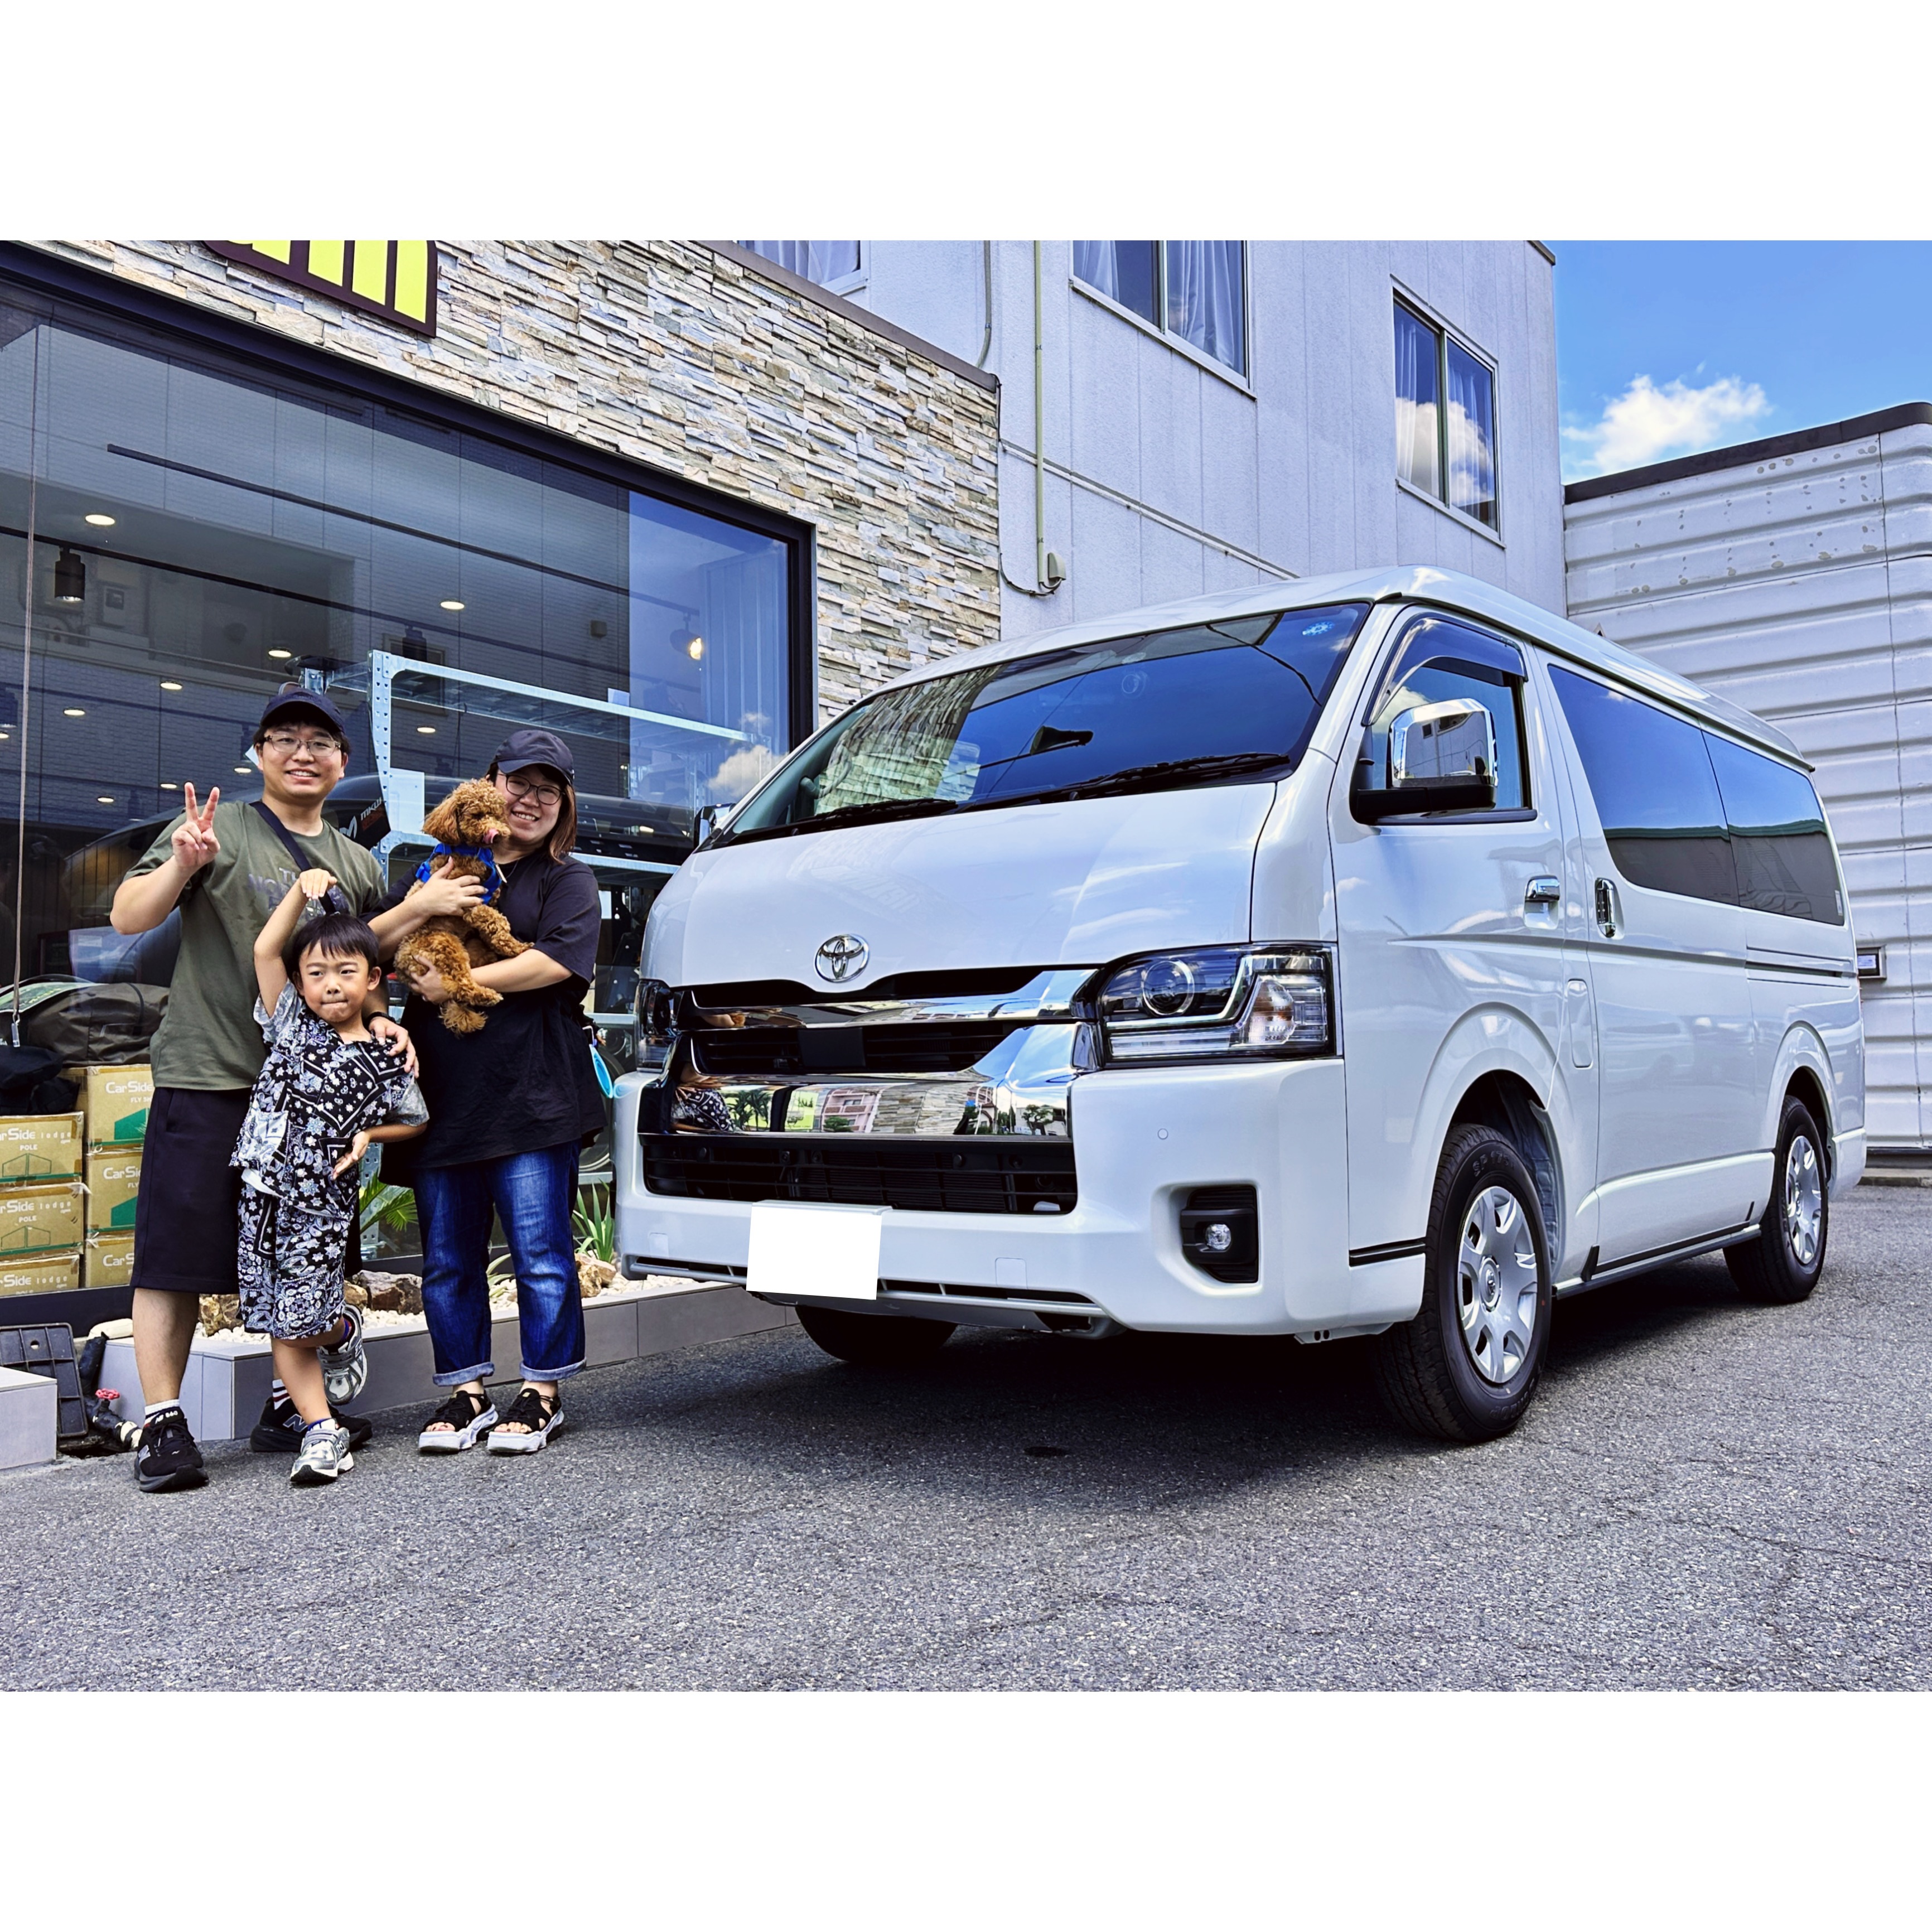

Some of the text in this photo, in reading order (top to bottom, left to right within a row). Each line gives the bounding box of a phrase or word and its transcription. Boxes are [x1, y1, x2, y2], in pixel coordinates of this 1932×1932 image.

[105, 1081, 153, 1094] CarSide
[0, 1128, 36, 1141] rSide
[103, 1166, 141, 1180] CarSi
[0, 1200, 35, 1214] rSide
[103, 1252, 134, 1267] CarS
[0, 1274, 31, 1288] Side
